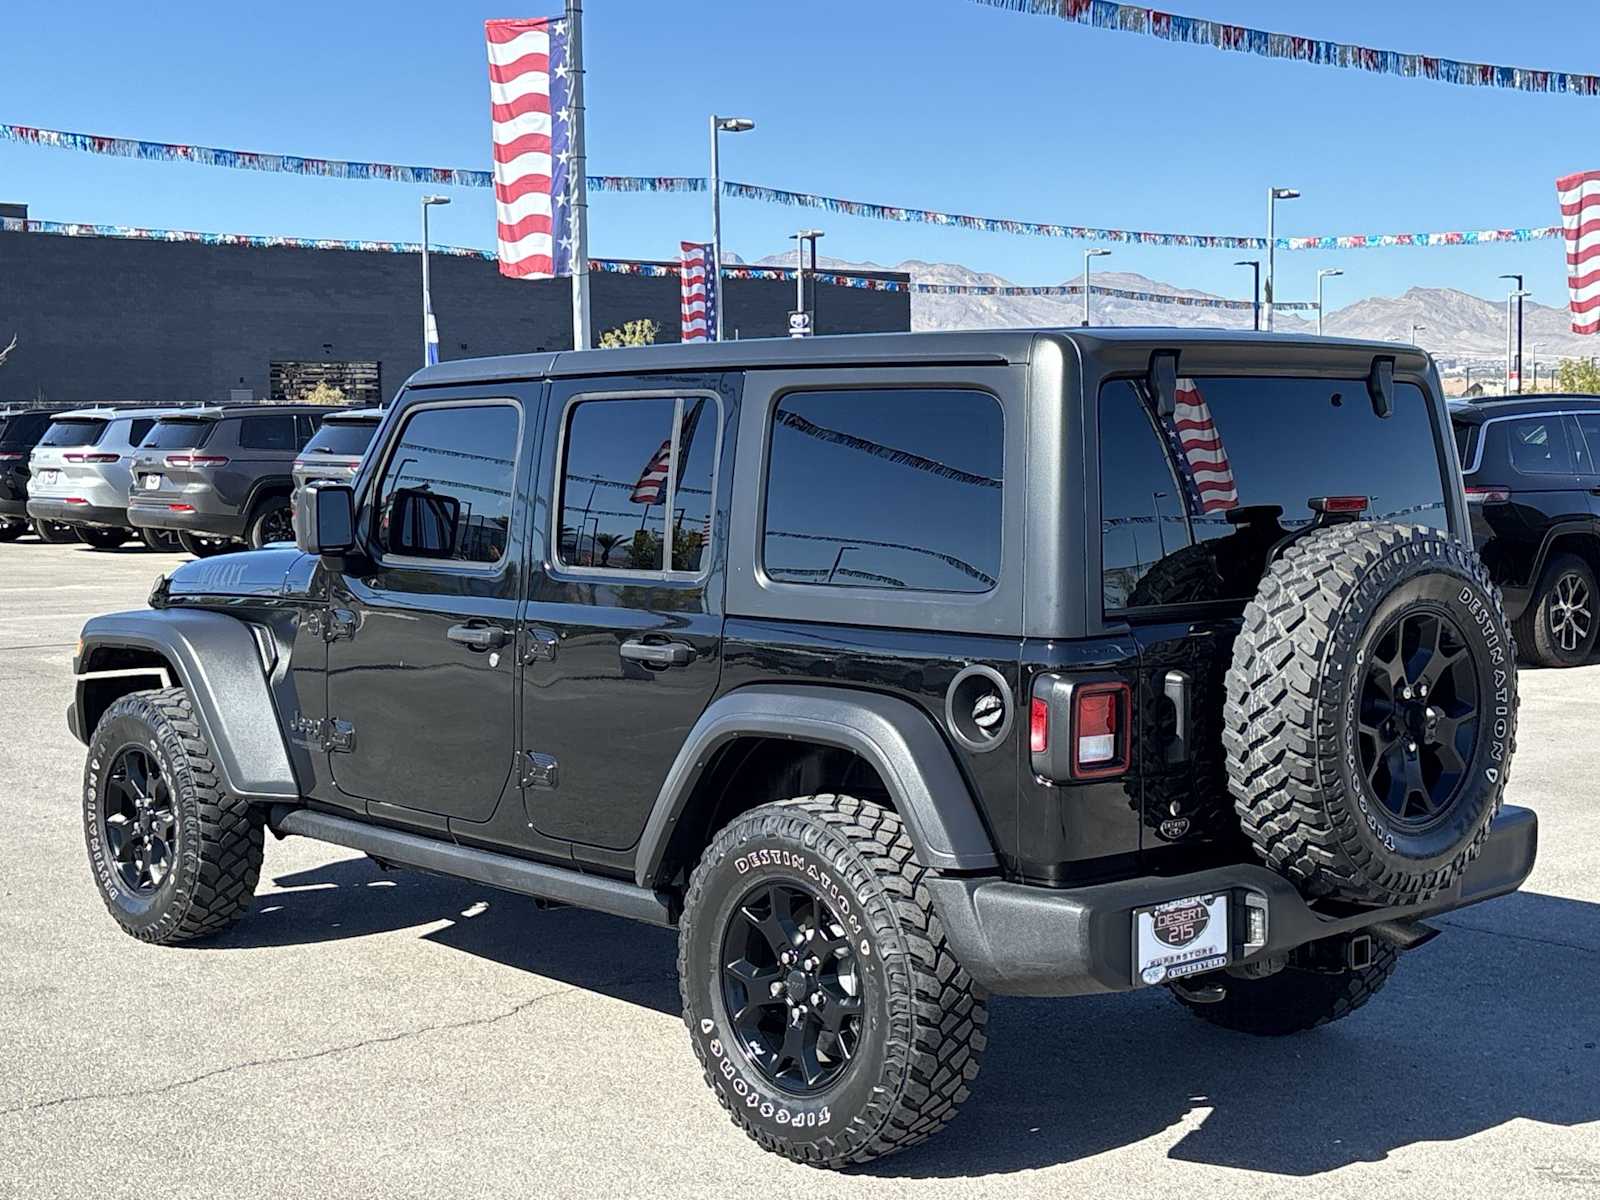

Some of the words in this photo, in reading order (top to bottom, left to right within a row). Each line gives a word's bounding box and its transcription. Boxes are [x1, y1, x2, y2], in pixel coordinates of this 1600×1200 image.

[1458, 586, 1508, 762] DESTINATION
[87, 772, 118, 901] DESTINATION
[734, 849, 863, 935] DESTINATION
[1157, 907, 1204, 926] DESERT
[1168, 922, 1195, 943] 215
[709, 1038, 832, 1128] FIRESTONE
